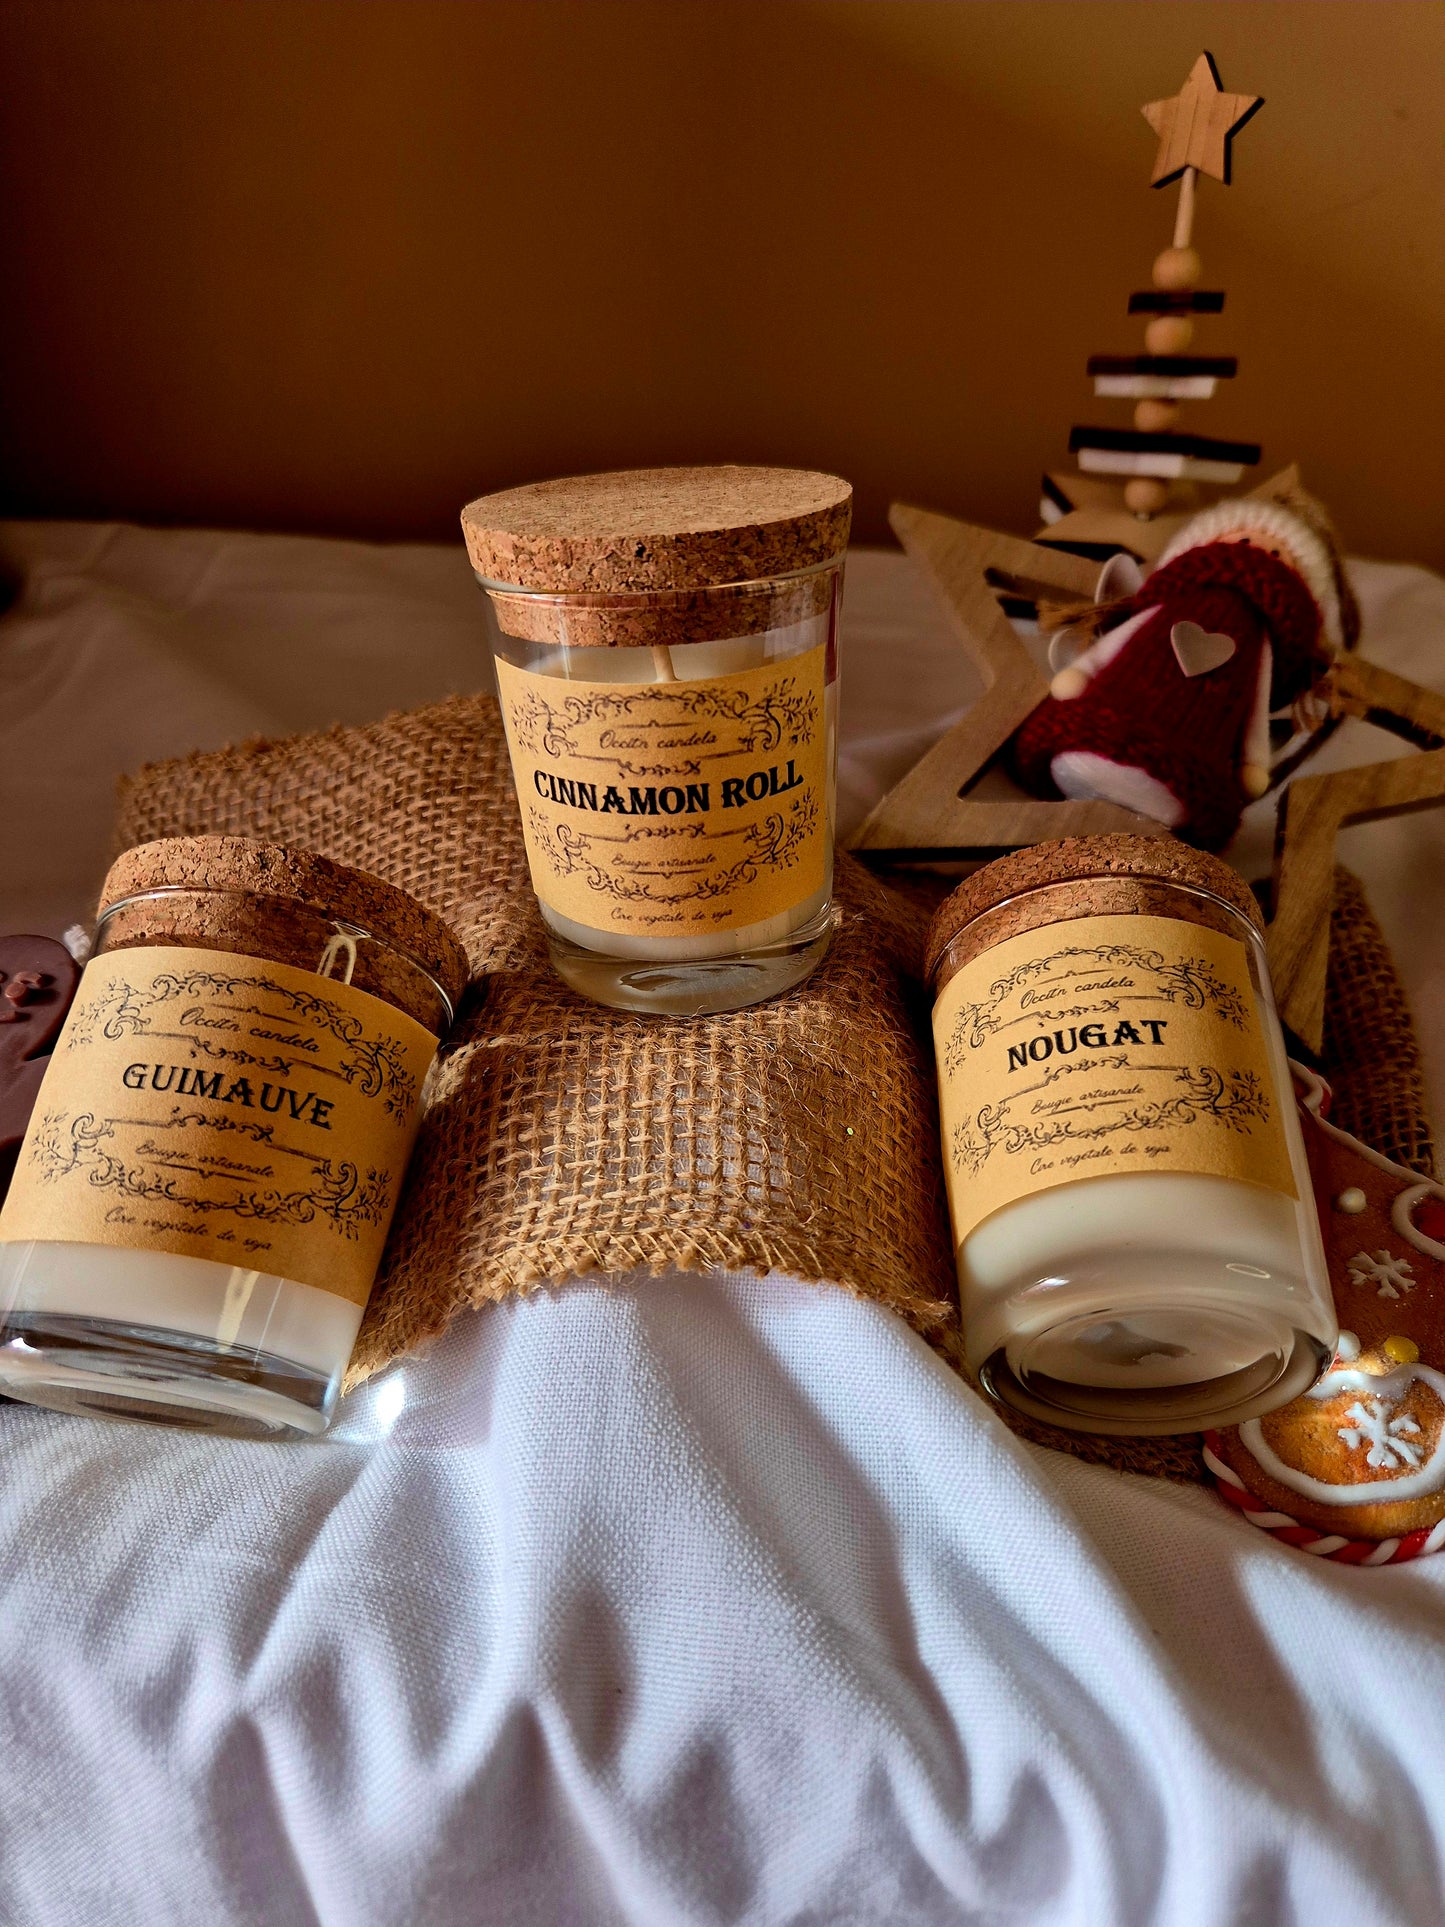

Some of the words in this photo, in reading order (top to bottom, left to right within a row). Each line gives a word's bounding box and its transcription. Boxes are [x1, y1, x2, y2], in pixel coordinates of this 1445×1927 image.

[534, 770, 710, 815] CINNAMON
[722, 760, 804, 808] ROLL
[1075, 976, 1135, 992] candela
[249, 1027, 320, 1053] candela
[1007, 1020, 1167, 1073] NOUGAT
[122, 1062, 335, 1130] GUIMAUVE
[1031, 1097, 1072, 1114] Bougie
[1079, 1084, 1145, 1100] artisanale
[1120, 1143, 1136, 1154] de
